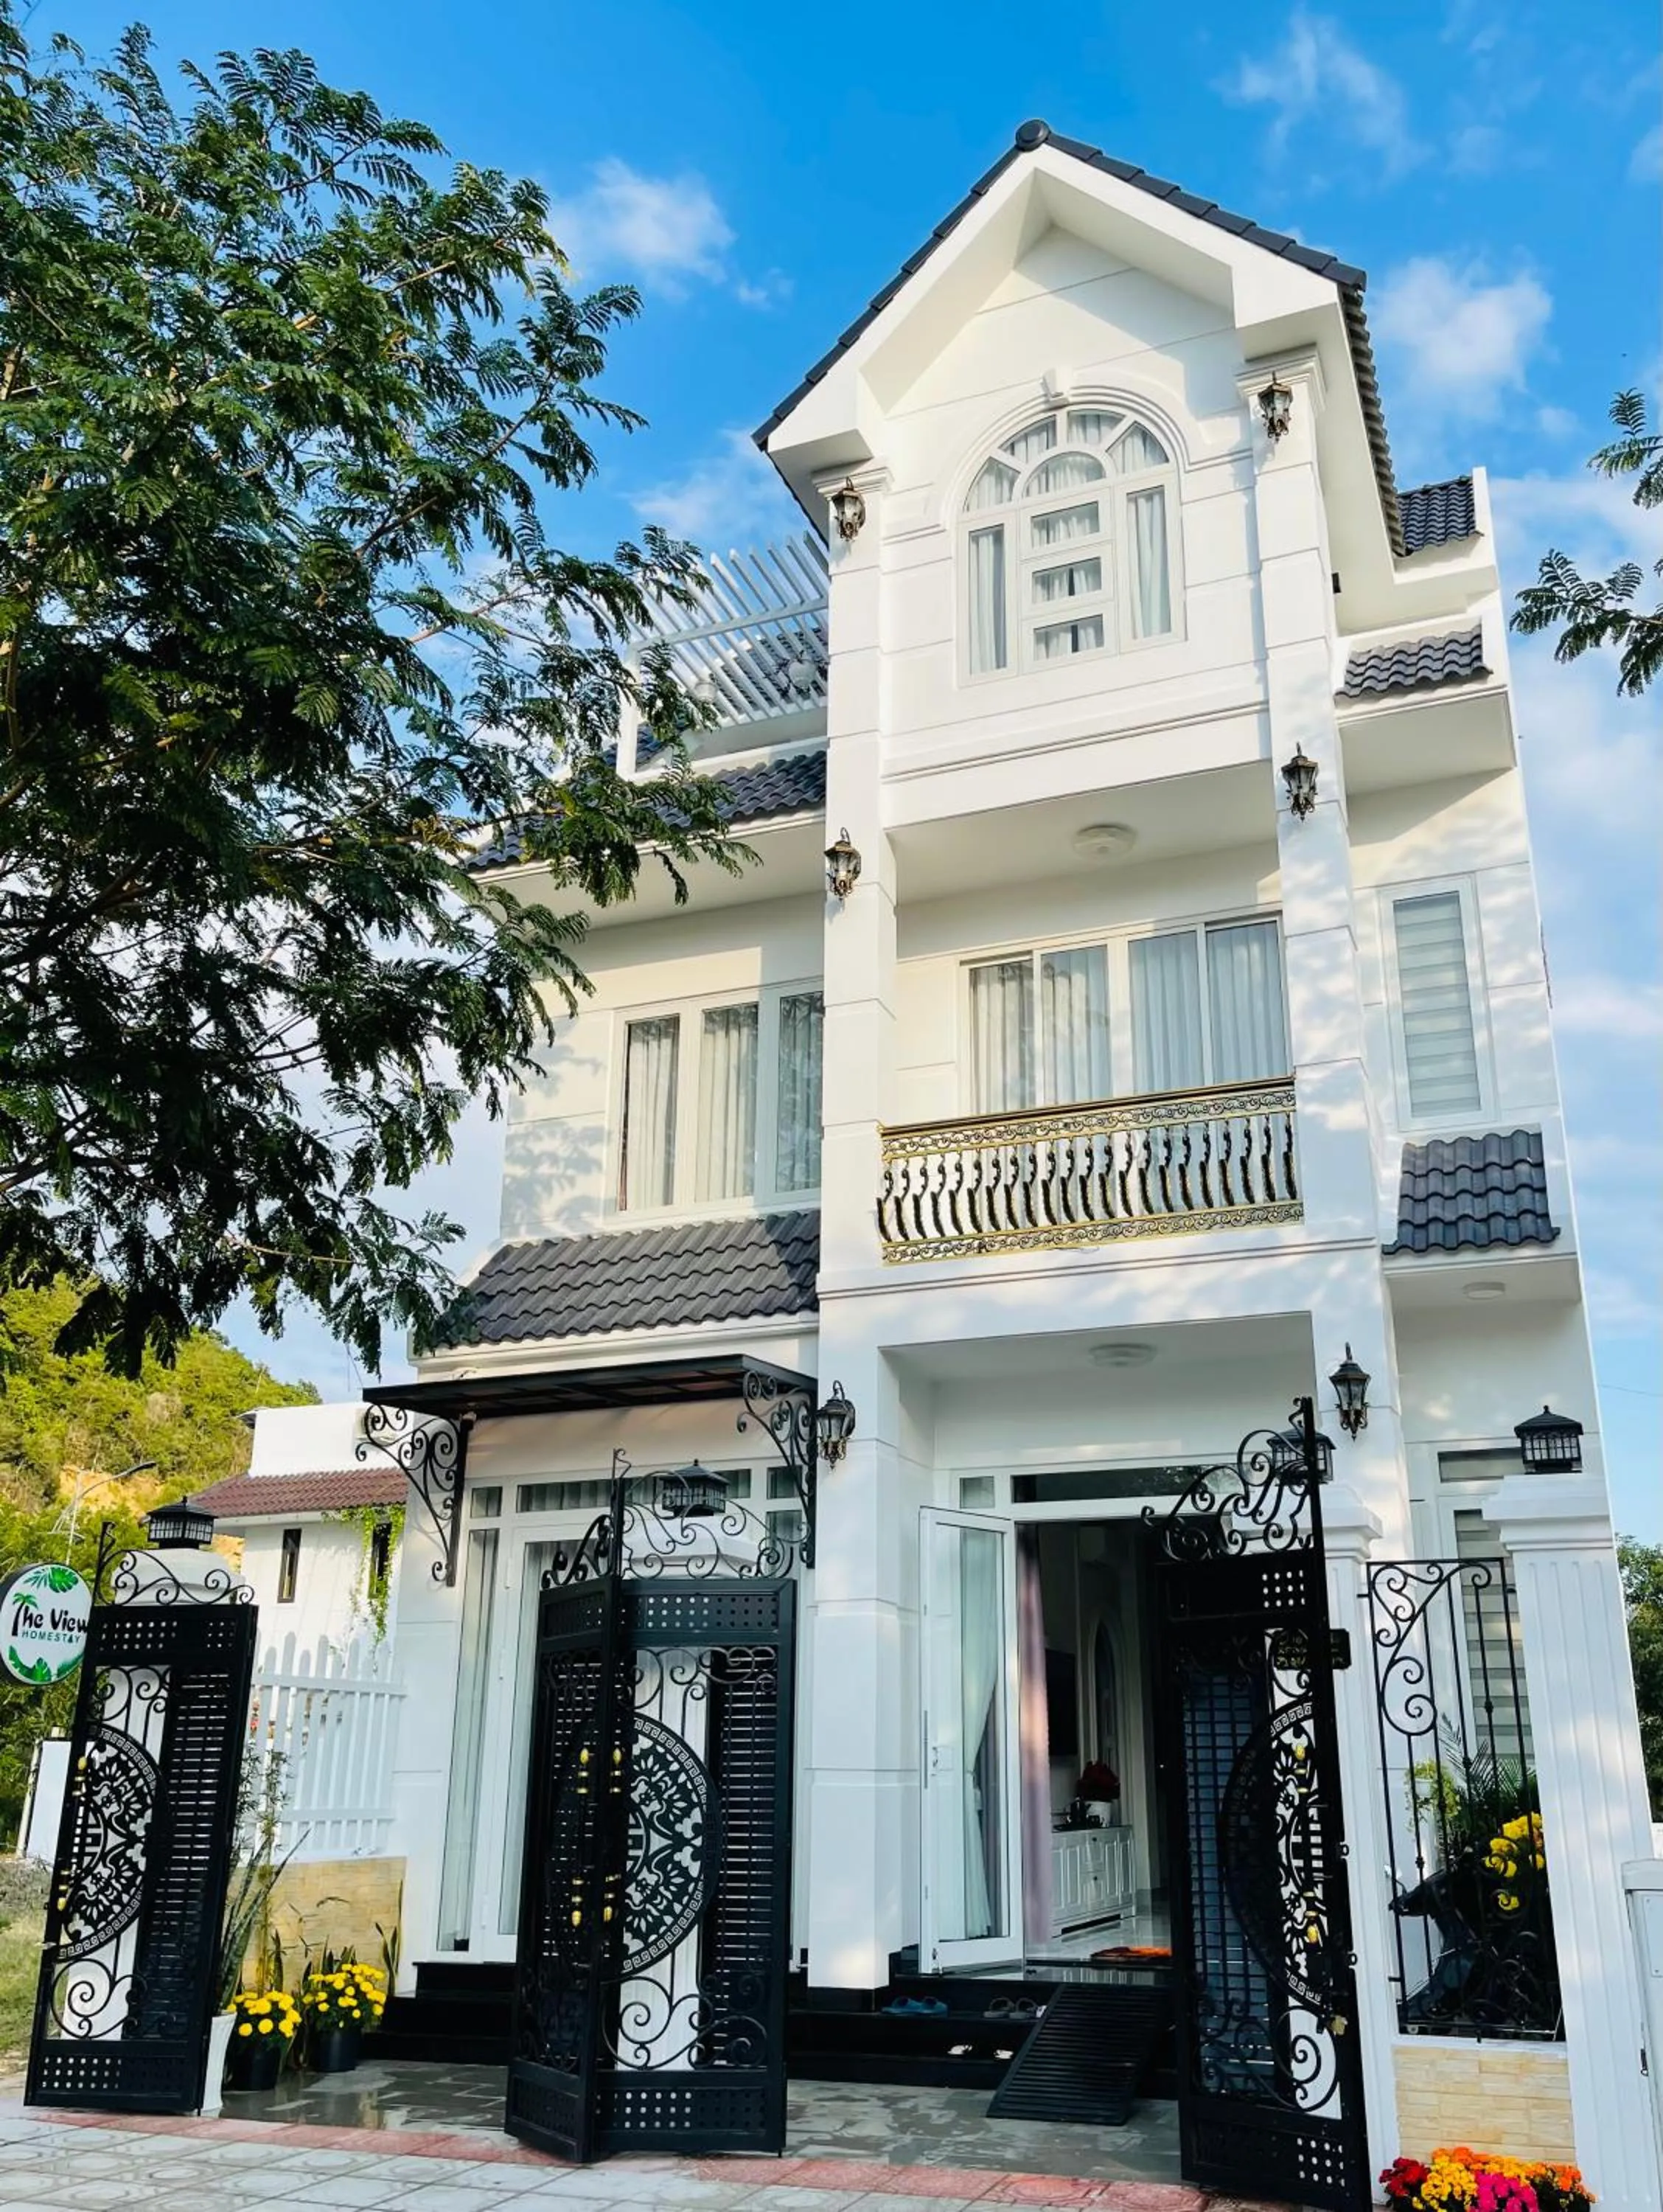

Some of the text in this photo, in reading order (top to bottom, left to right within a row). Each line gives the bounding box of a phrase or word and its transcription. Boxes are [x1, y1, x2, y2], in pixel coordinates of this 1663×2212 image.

[12, 1593, 87, 1636] The View
[21, 1630, 80, 1644] HOMESTAY
